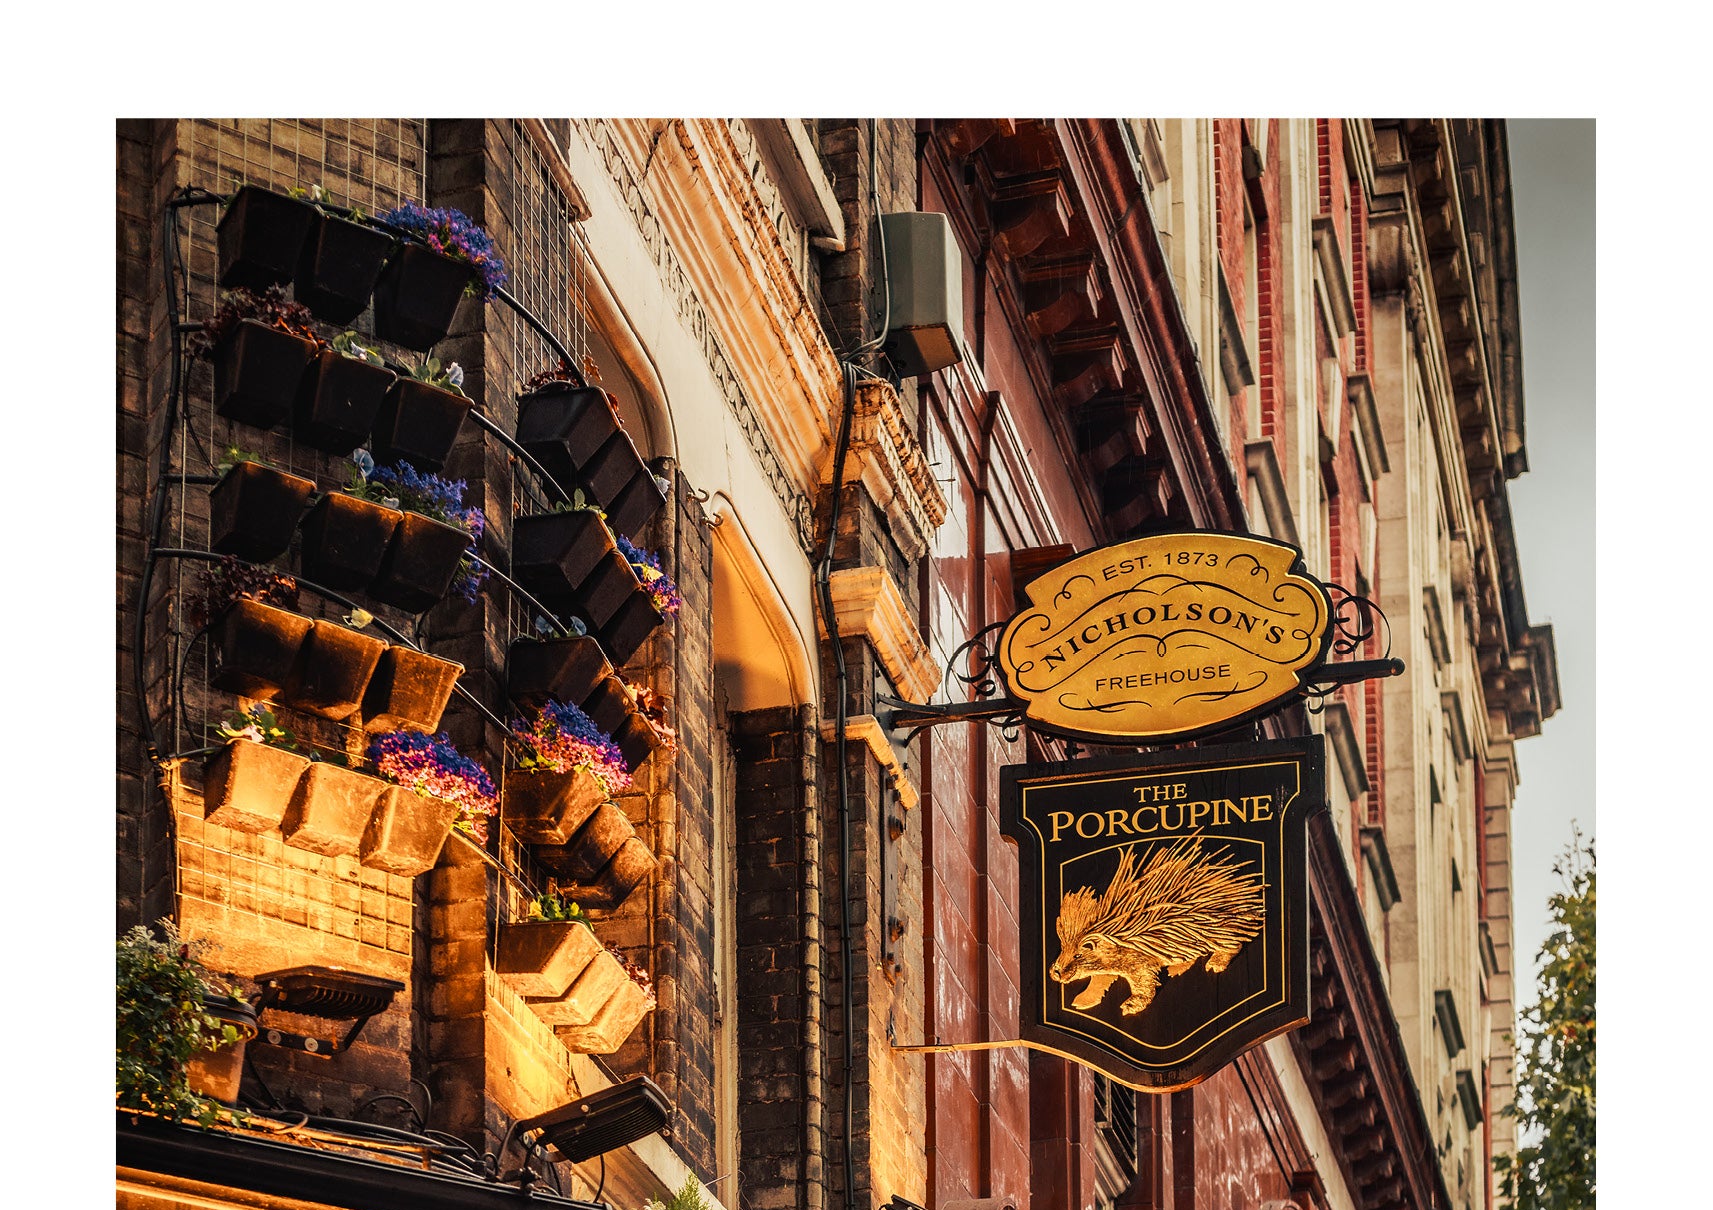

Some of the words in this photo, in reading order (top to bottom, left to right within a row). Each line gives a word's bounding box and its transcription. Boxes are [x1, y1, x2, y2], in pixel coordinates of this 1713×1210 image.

[1102, 555, 1152, 581] EST.
[1164, 551, 1219, 567] 1873
[1041, 603, 1285, 673] NICHOLSON'S
[1095, 663, 1231, 692] FREEHOUSE
[1133, 782, 1188, 803] THE
[1047, 794, 1273, 842] PORCUPINE
